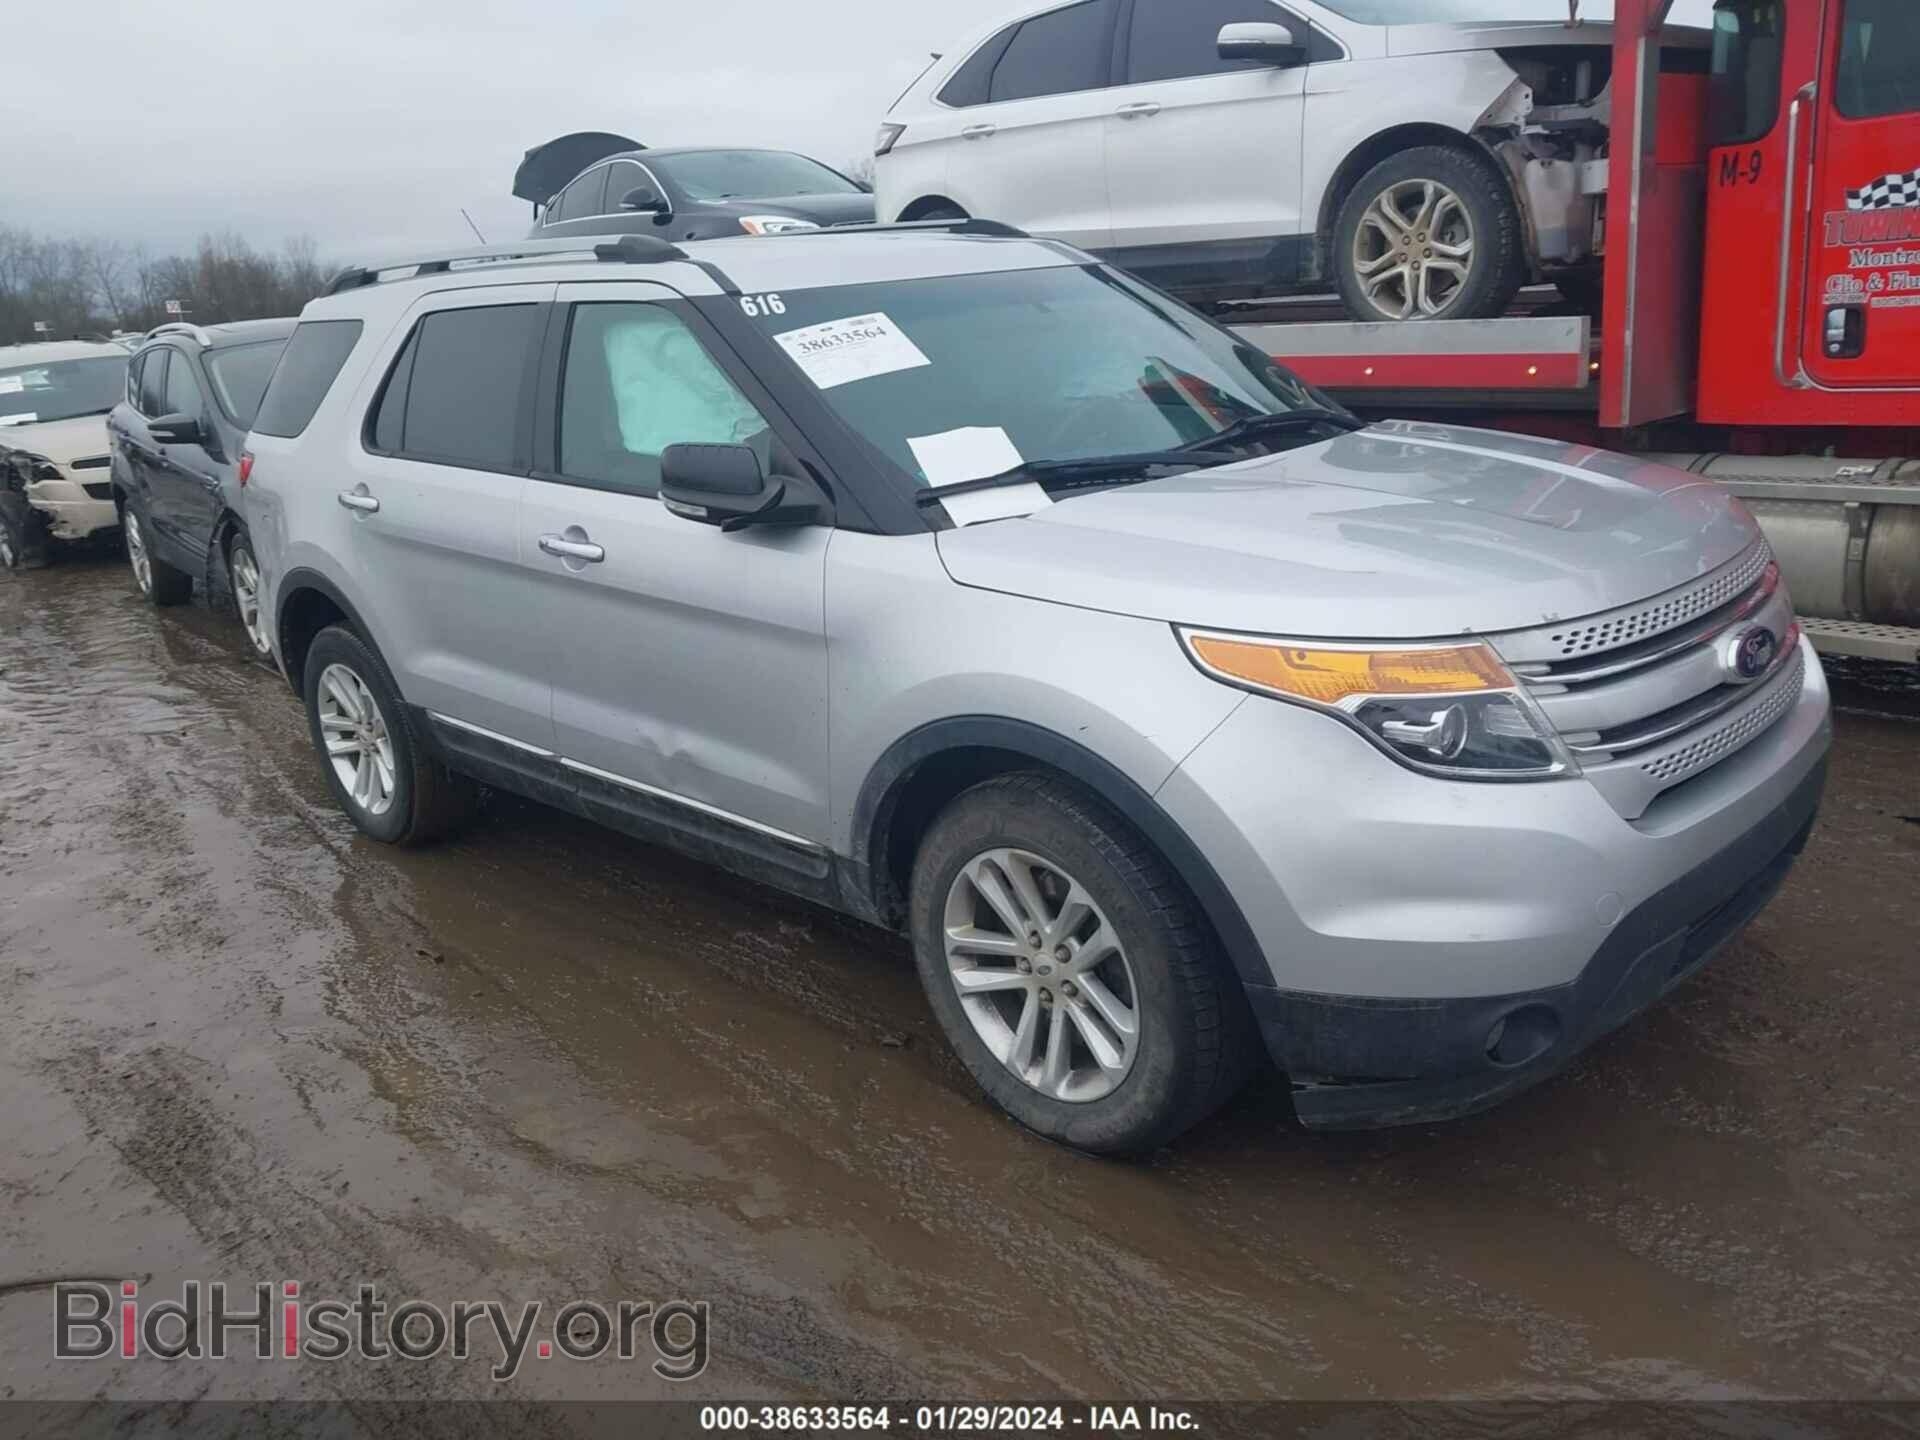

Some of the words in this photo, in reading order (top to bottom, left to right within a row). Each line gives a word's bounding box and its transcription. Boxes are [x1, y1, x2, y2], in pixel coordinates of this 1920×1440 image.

[1720, 150, 1761, 187] M-9
[1866, 272, 1885, 291] &
[740, 293, 786, 317] 616
[798, 326, 887, 354] 38633564
